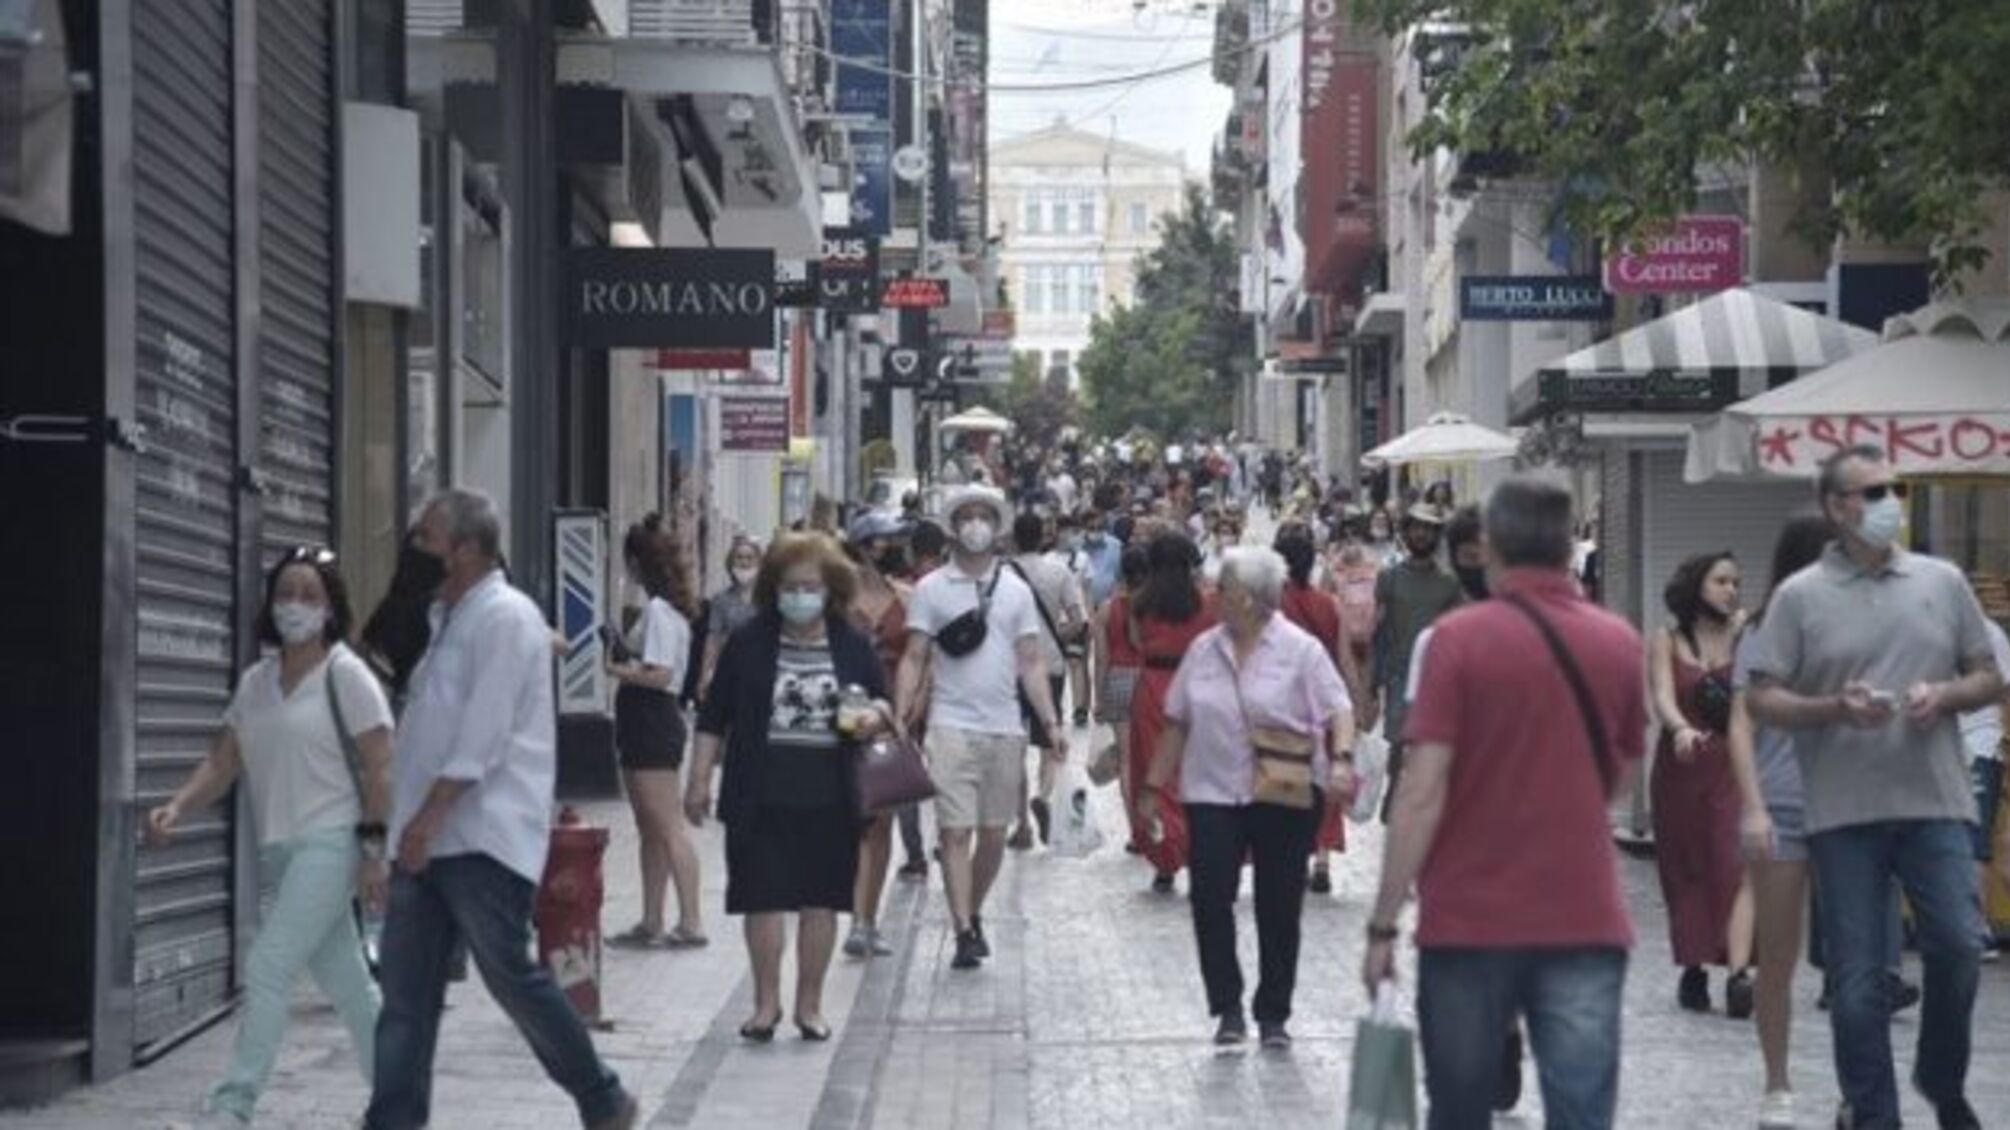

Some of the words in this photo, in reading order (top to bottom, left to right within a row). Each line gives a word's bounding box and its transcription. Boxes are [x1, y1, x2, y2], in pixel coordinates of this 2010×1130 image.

[1620, 227, 1731, 255] ondos
[1618, 256, 1719, 283] Center
[582, 277, 766, 316] ROMANO
